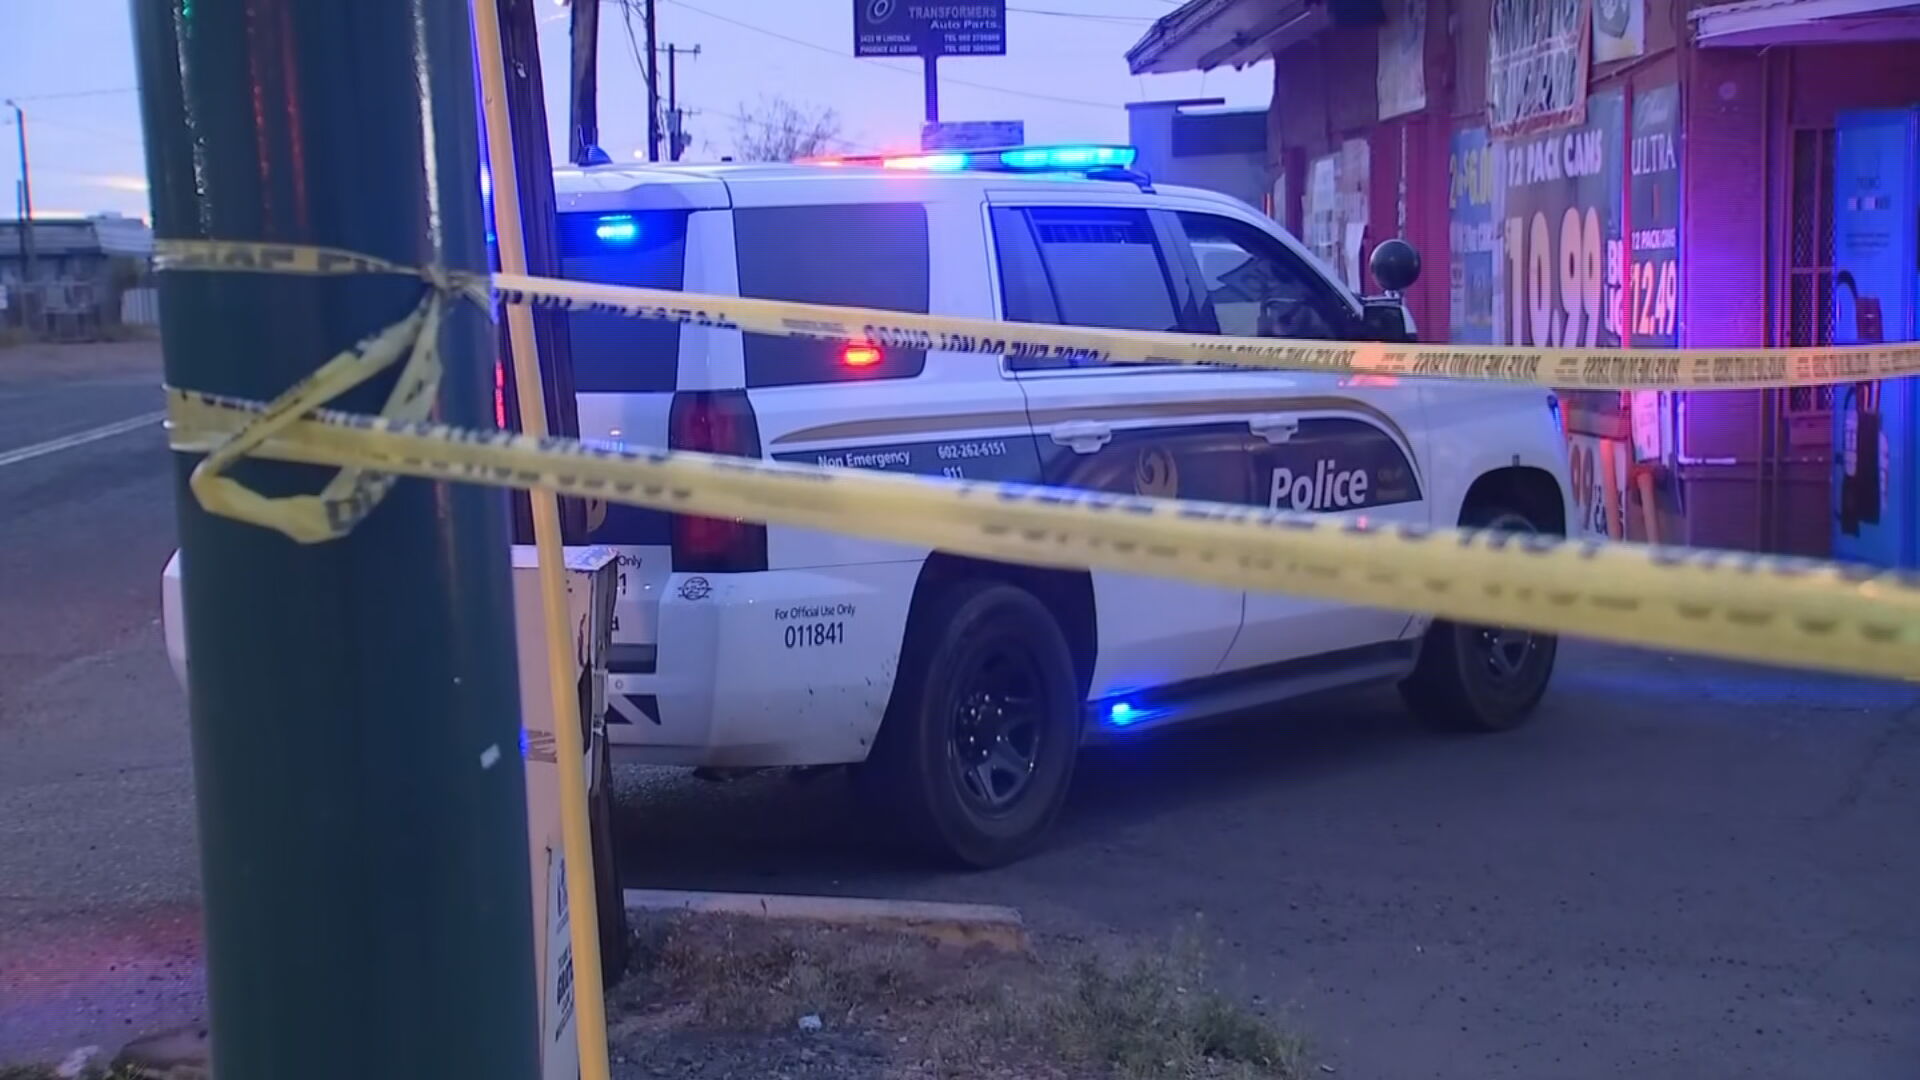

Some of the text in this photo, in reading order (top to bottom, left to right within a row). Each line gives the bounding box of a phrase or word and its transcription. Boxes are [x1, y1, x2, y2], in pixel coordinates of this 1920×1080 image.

[908, 6, 997, 19] TRANSFORMERS
[930, 20, 961, 29] Auto
[1527, 136, 1561, 185] PACK
[1563, 127, 1603, 178] CANS
[1631, 133, 1677, 176] ULTRA
[818, 450, 911, 469] Non Emergency
[938, 441, 1007, 460] 602-262-6151
[943, 466, 964, 479] 911
[1269, 460, 1368, 511] Police
[618, 555, 642, 569] Only
[775, 603, 856, 620] For Official Use Only
[785, 621, 844, 649] 011841
